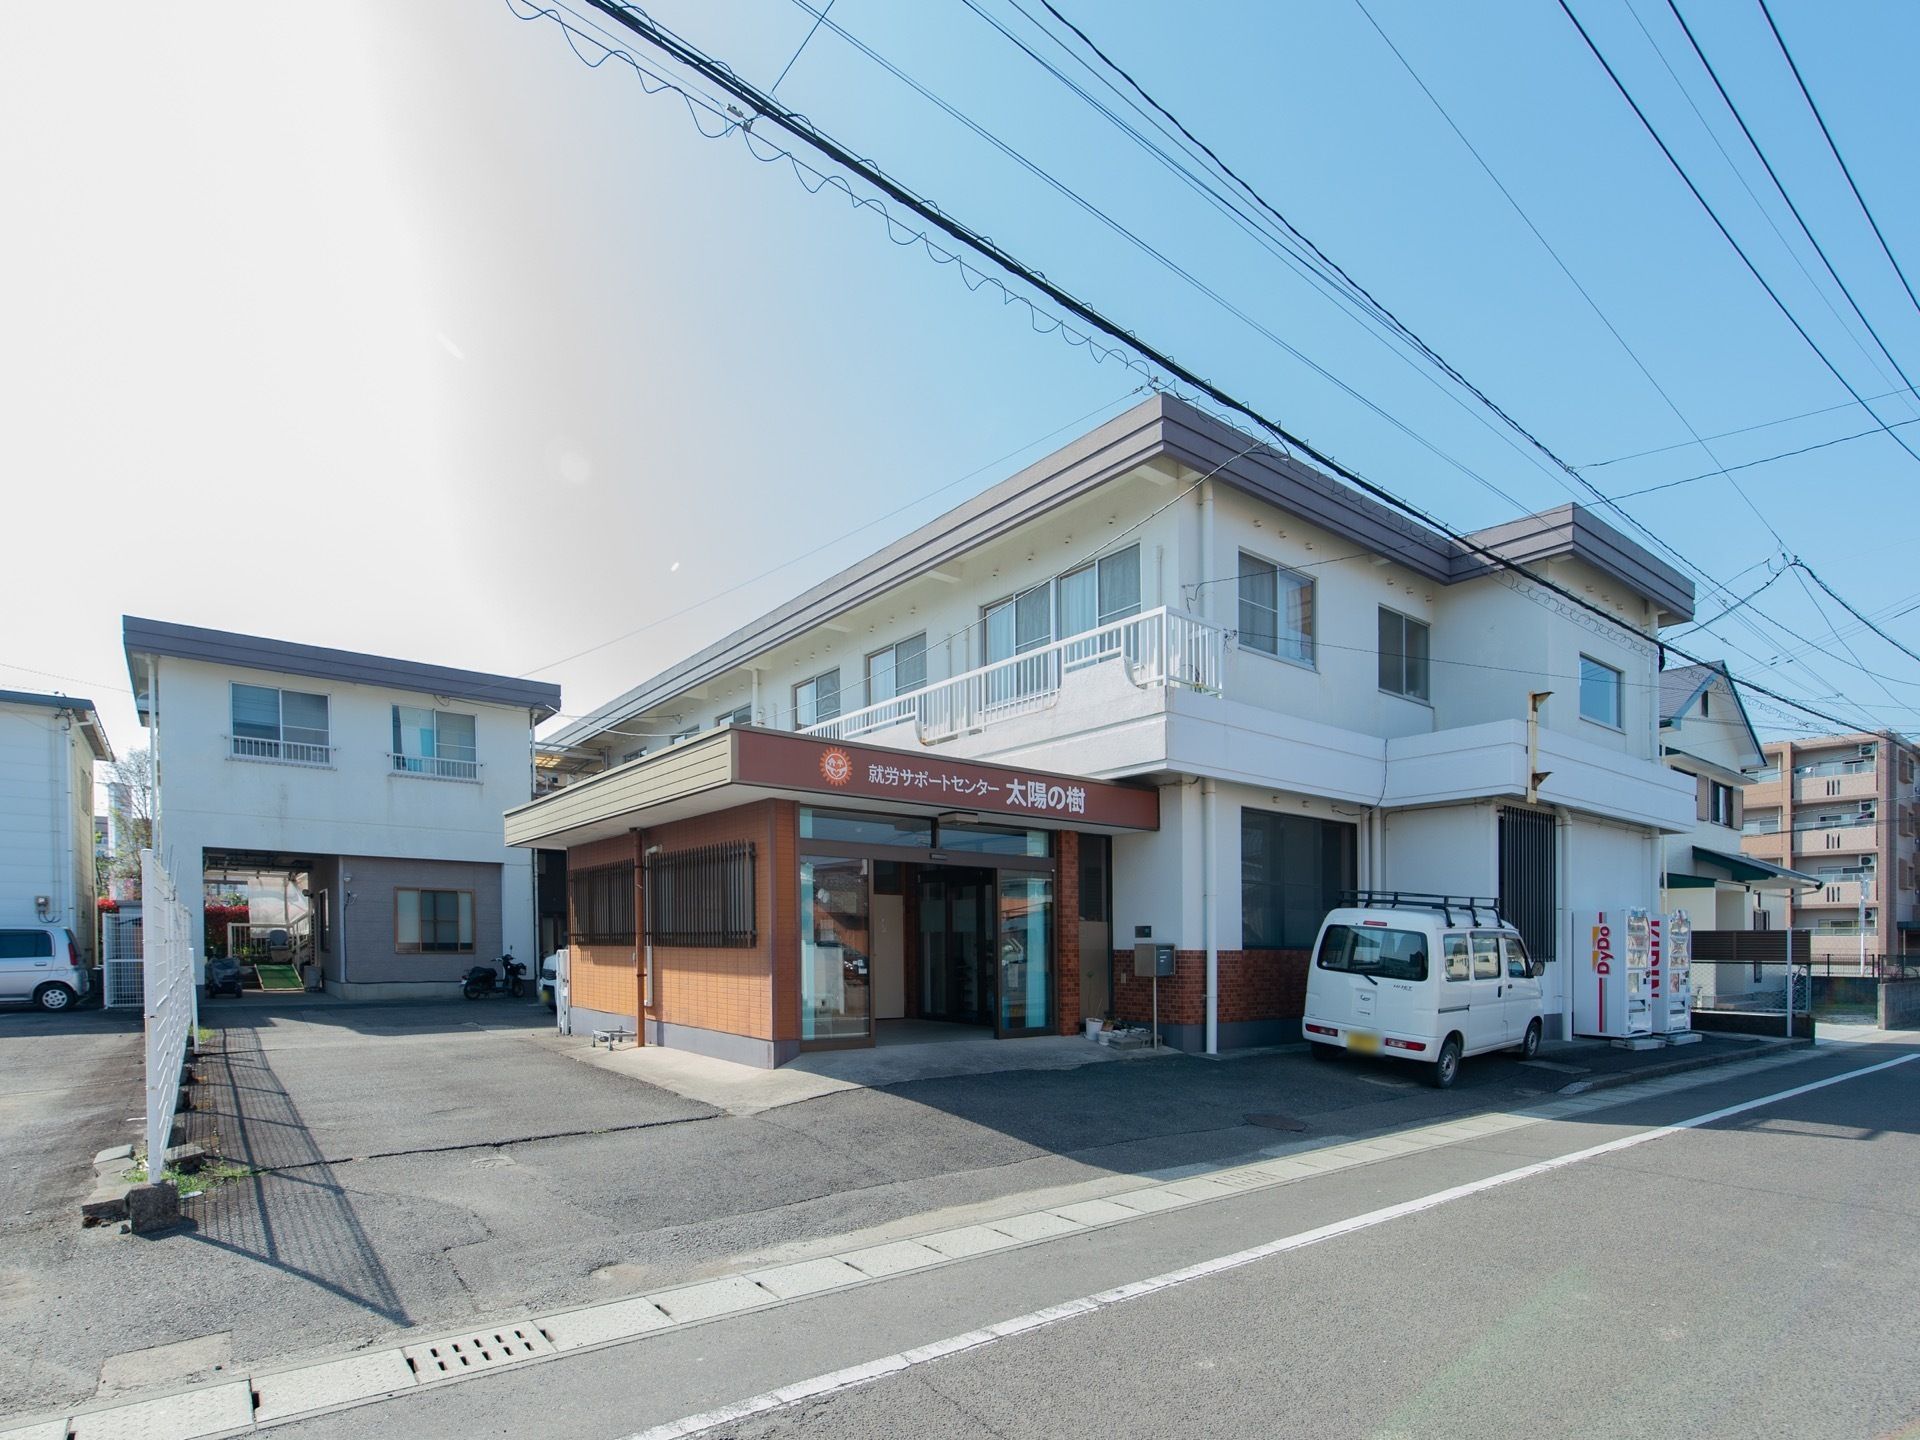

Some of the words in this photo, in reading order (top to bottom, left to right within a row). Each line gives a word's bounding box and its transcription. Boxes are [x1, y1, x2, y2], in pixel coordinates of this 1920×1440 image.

[868, 764, 999, 796] 就労サポートセンター
[1005, 778, 1085, 814] 太陽の樹
[1597, 926, 1614, 975] DyDo
